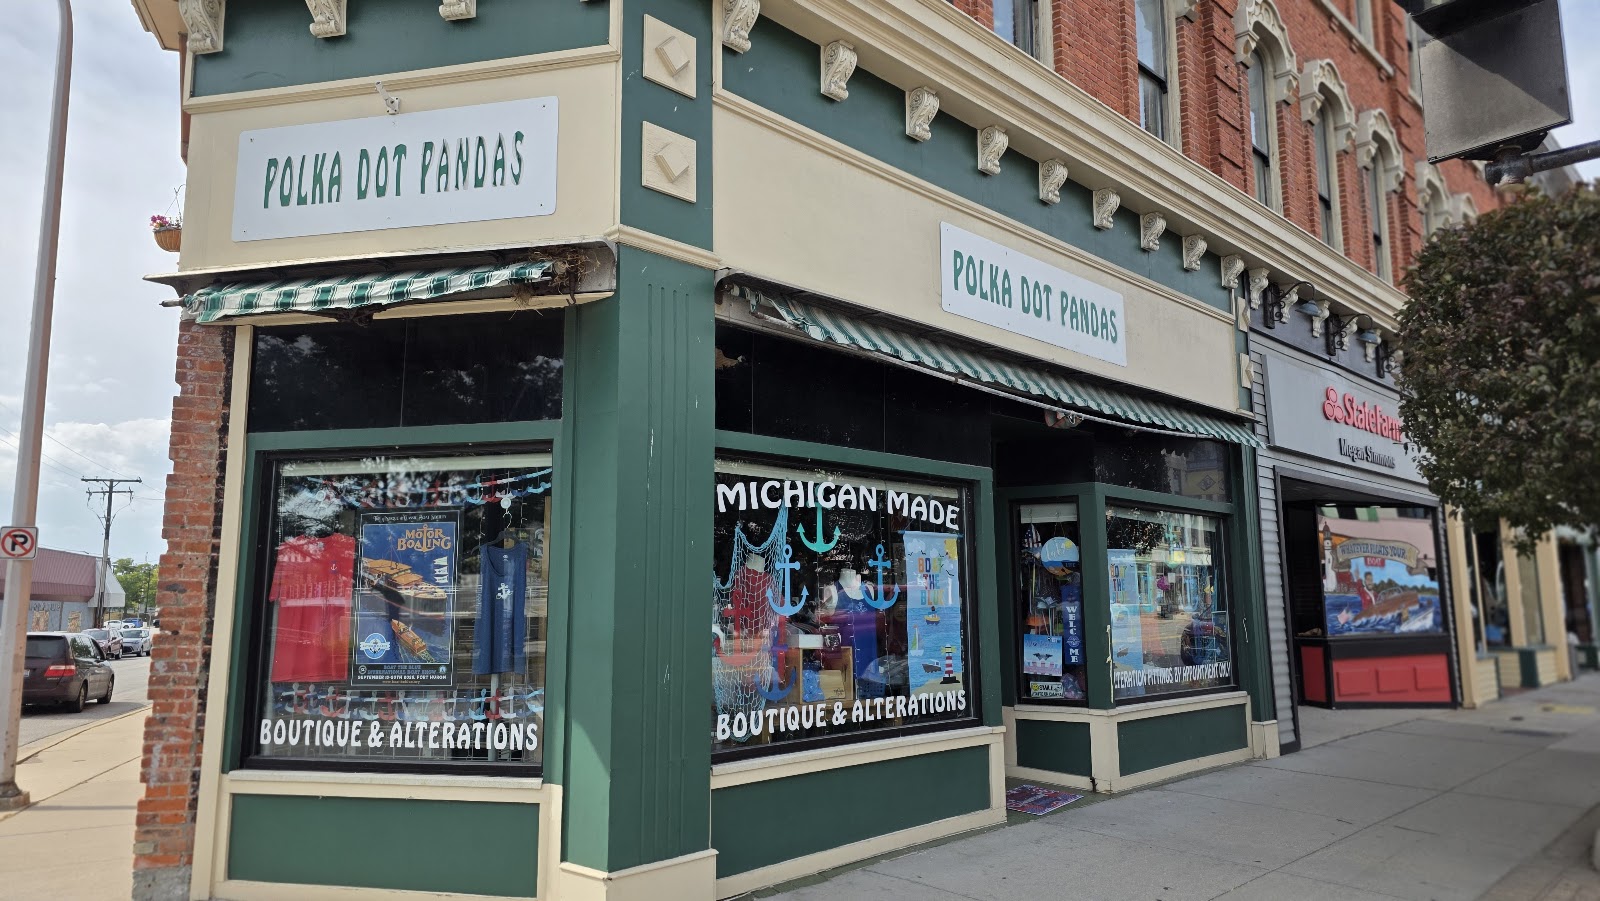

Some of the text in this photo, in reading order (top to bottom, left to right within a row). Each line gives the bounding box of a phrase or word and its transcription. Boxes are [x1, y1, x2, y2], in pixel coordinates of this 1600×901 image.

[264, 130, 525, 209] POLKA DOT PANDAS
[953, 249, 1118, 344] POLKA DOT PANDAS
[1338, 437, 1365, 463] Megan
[716, 480, 961, 531] MICHIGAN MADE
[917, 557, 943, 573] BOAT
[922, 574, 940, 589] THE
[260, 718, 538, 751] BOUTIQUE & ALTERATIONS
[716, 689, 967, 741] BOUTIQUE & ALTERATIONS
